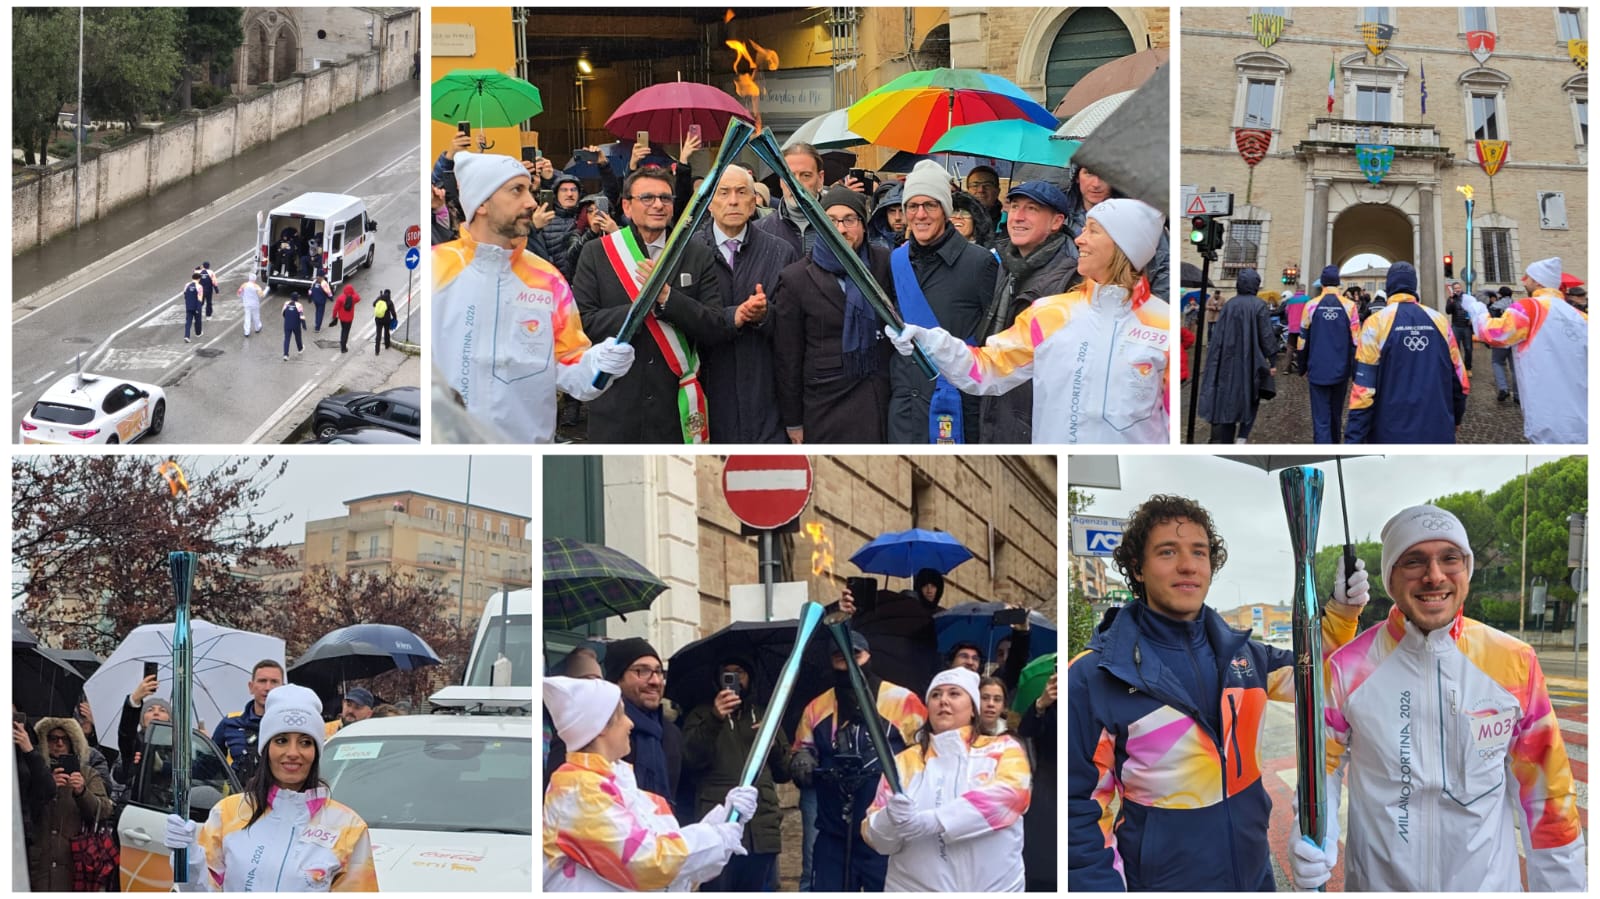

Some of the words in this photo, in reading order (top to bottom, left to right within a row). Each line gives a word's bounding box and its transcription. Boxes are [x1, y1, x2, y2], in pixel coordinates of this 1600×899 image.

[466, 304, 476, 326] 2026
[1077, 341, 1088, 363] 2026
[1073, 516, 1108, 526] Agenzia
[1400, 690, 1411, 719] 2026
[250, 845, 265, 865] 2026
